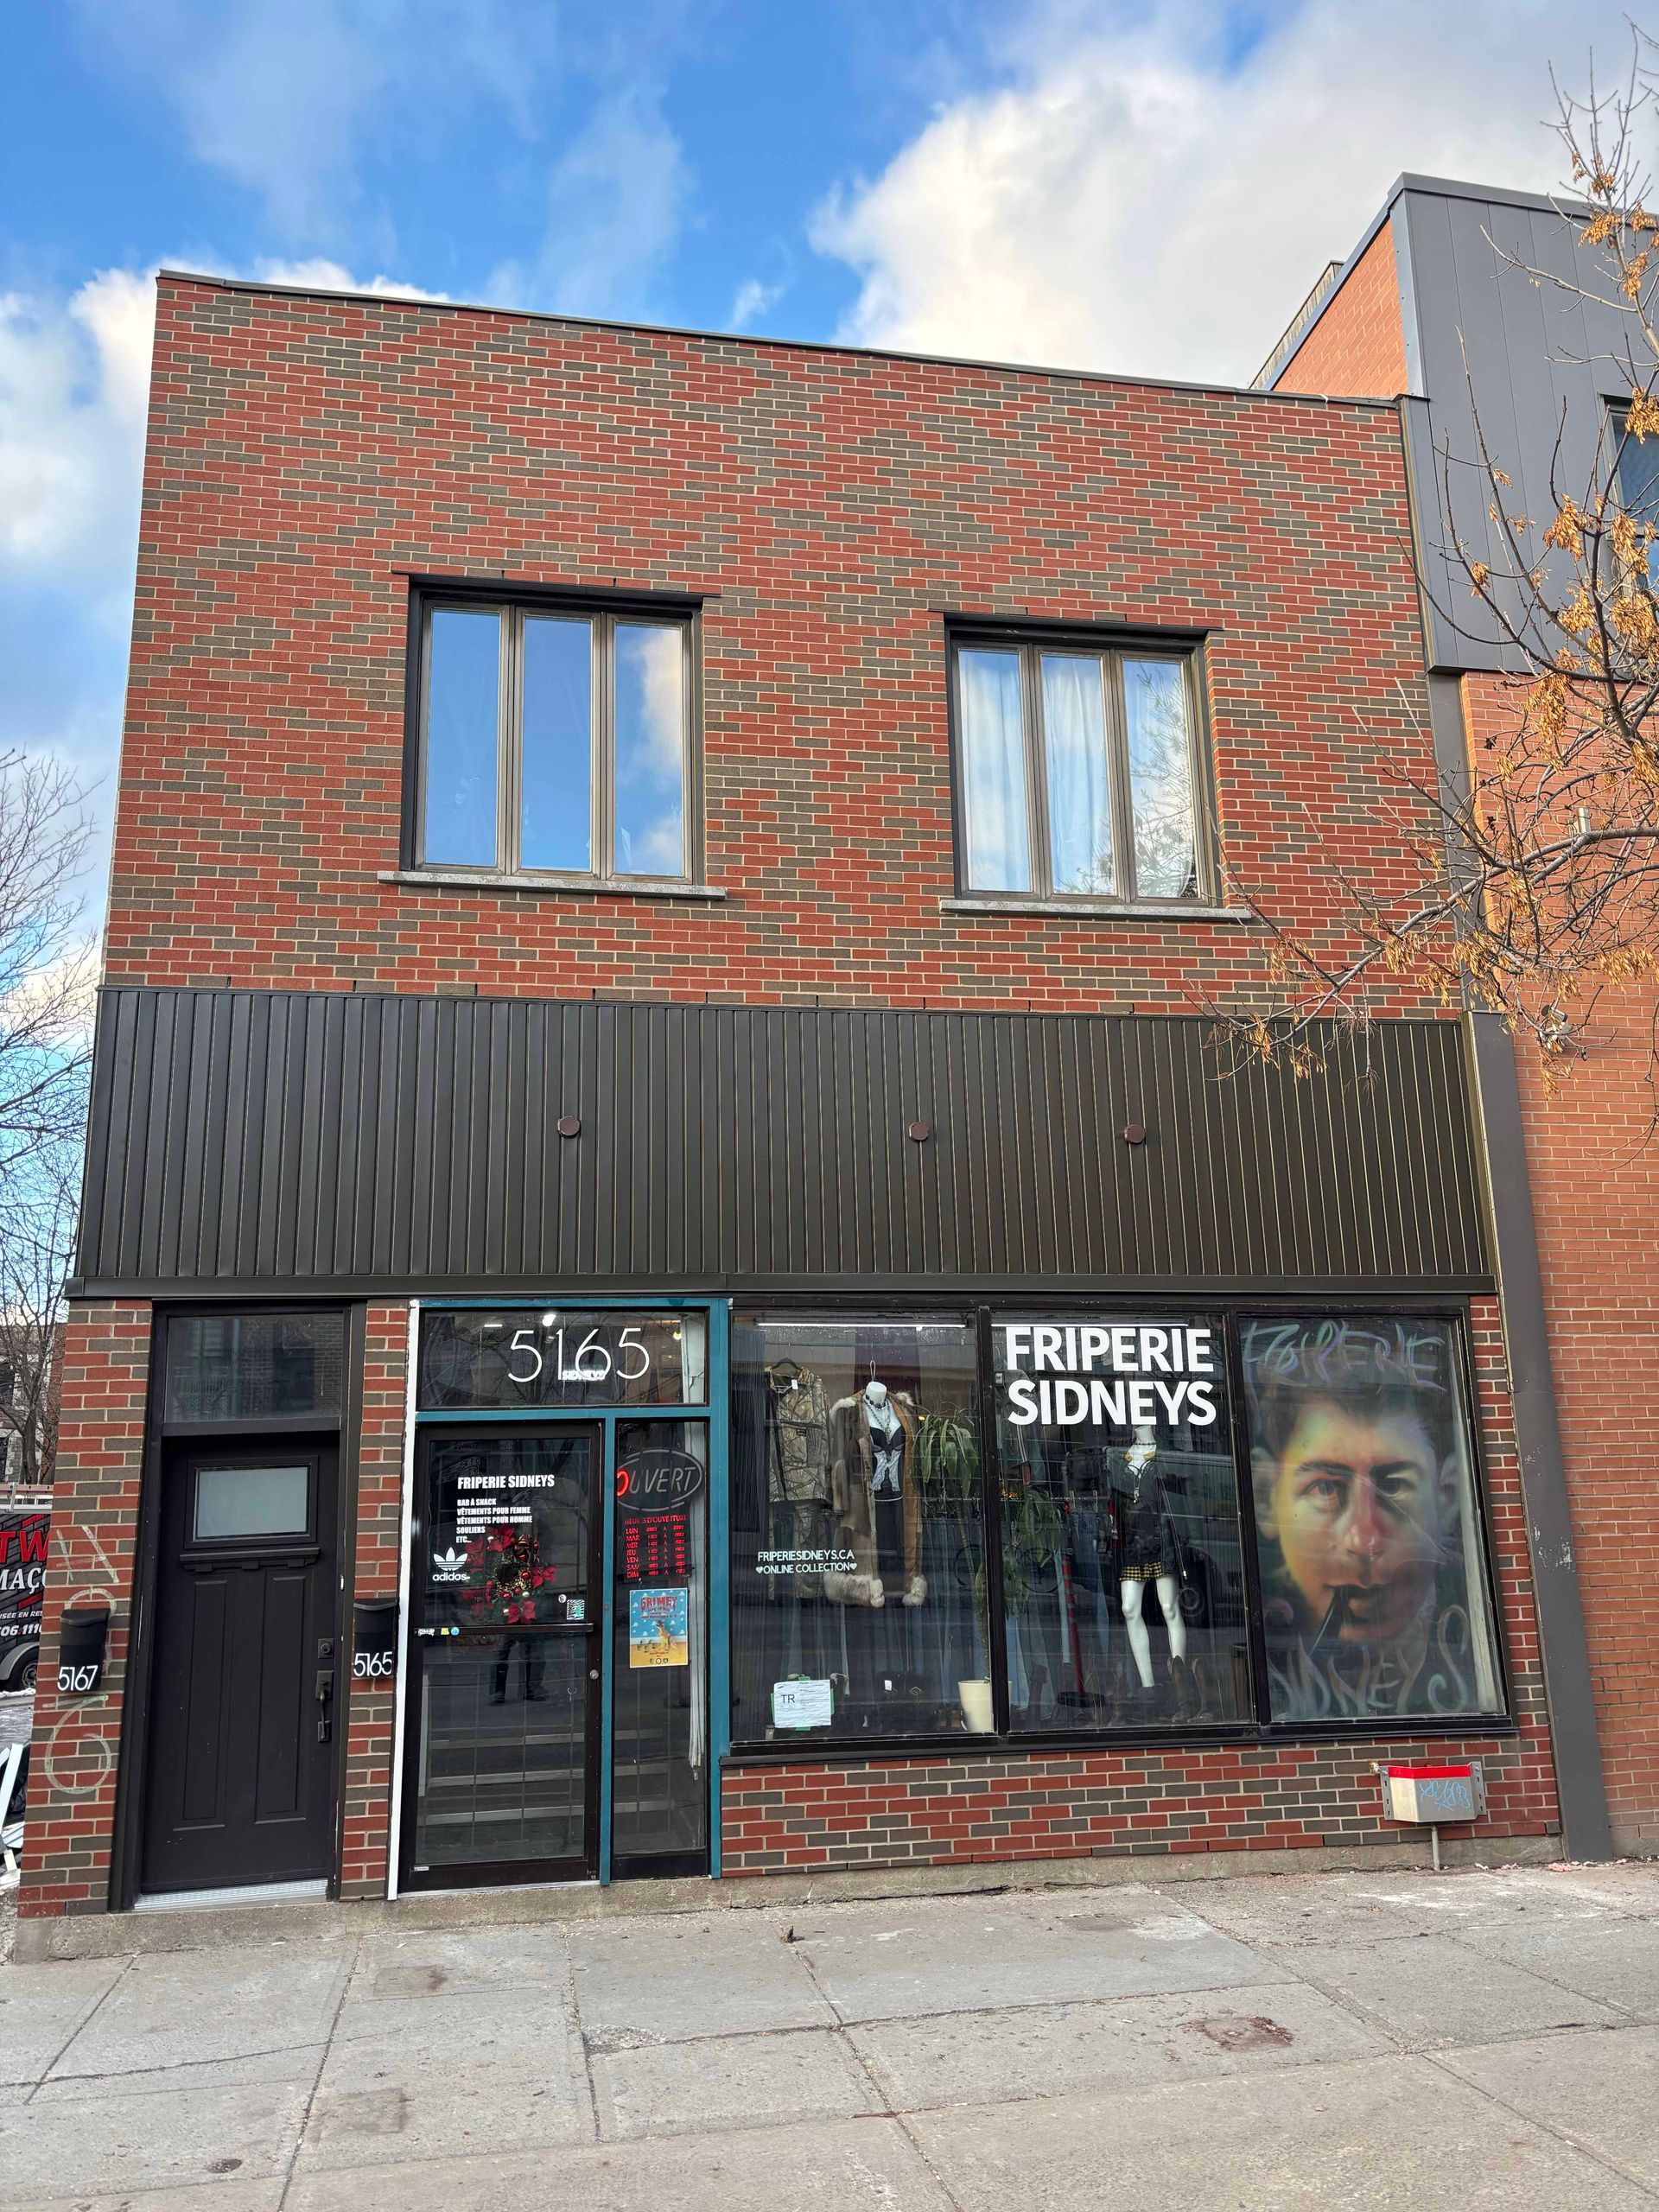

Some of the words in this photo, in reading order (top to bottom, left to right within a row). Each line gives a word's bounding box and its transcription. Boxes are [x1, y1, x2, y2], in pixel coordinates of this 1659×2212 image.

[507, 1327, 650, 1382] 5165
[1006, 1326, 1214, 1372] FRIPERIE
[1007, 1379, 1217, 1426] SIDNEYS
[457, 1476, 506, 1490] FRIPERIE
[508, 1474, 555, 1487] SIDNEYS
[617, 1467, 696, 1497] OUVERT
[457, 1507, 492, 1516] VÊTEMENTS
[456, 1516, 491, 1525] VÊTEMENTS
[456, 1526, 486, 1535] SOULIERS
[757, 1549, 855, 1562] FRIPERIESIDNEYS.CA
[763, 1565, 794, 1574] ONLINE
[795, 1562, 850, 1573] COLLECTION
[432, 1572, 467, 1581] adidas
[0, 1623, 42, 1637] 06.111
[353, 1651, 393, 1676] 5165
[57, 1665, 99, 1691] 5167
[780, 1694, 796, 1704] TR
